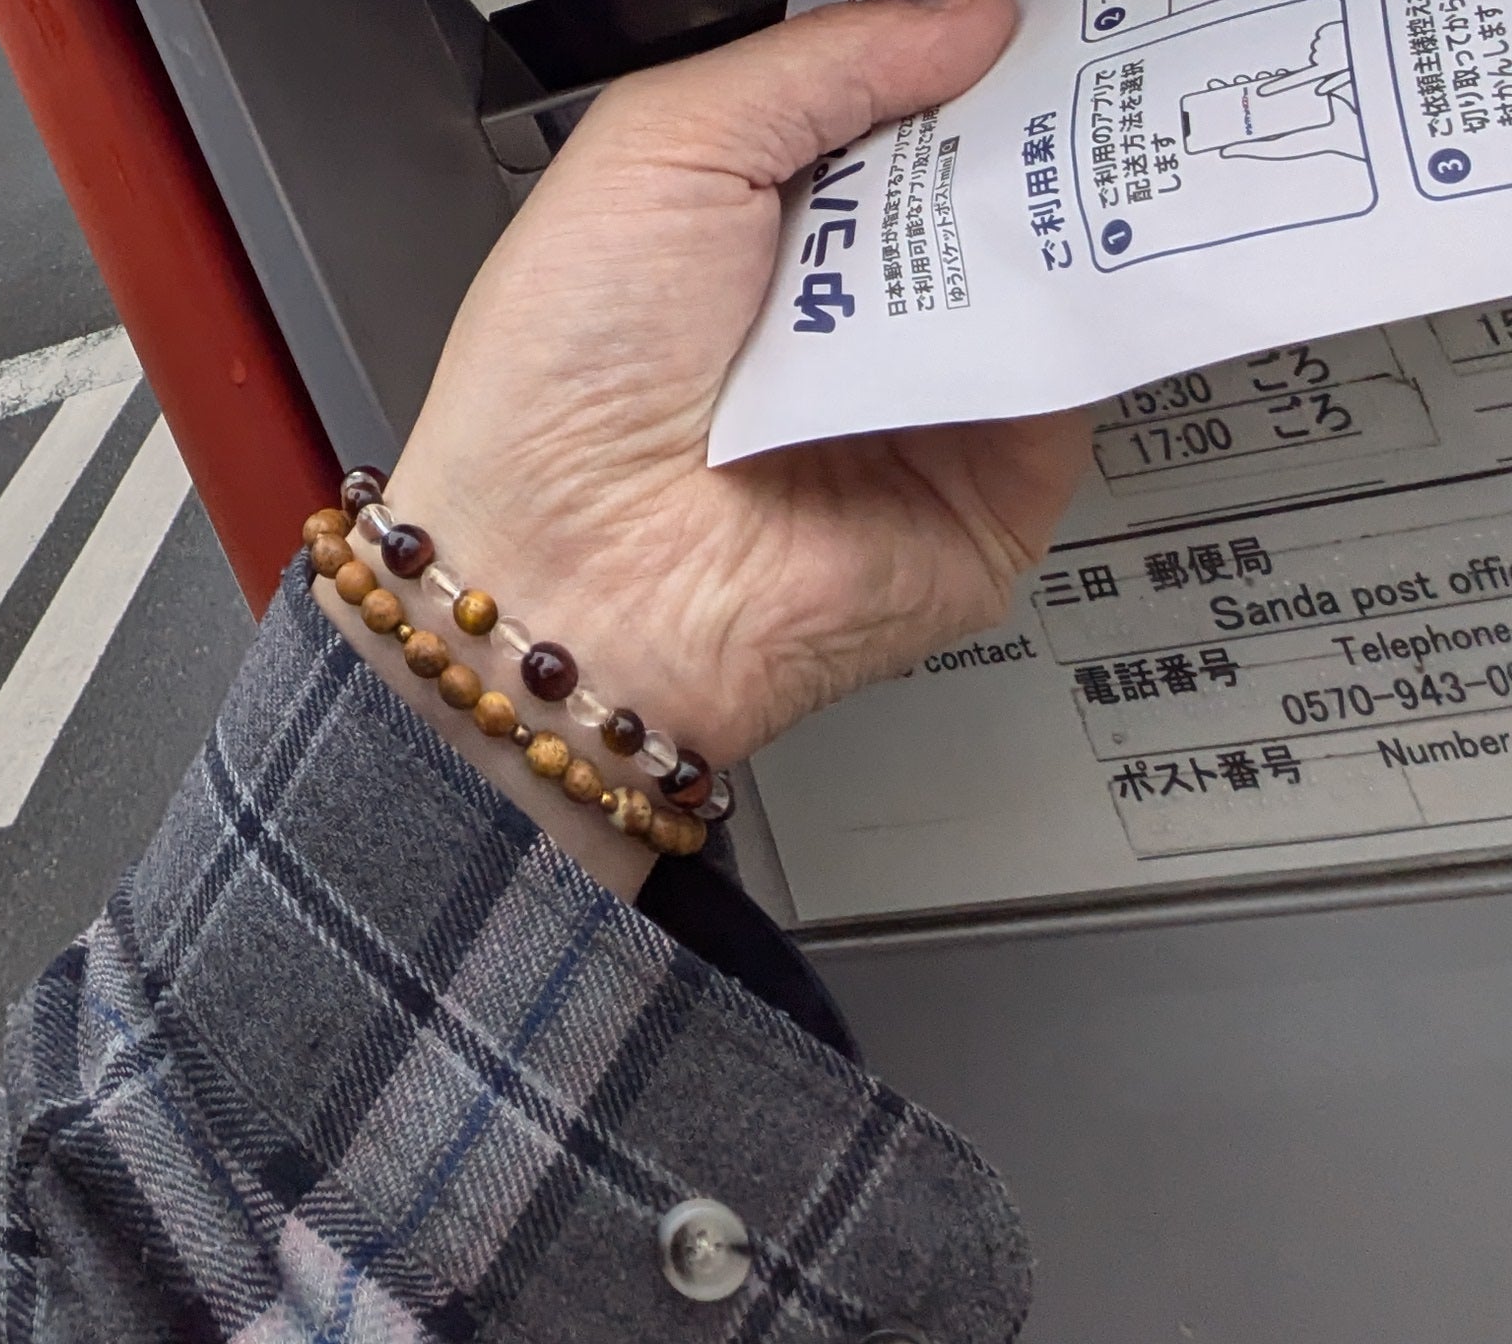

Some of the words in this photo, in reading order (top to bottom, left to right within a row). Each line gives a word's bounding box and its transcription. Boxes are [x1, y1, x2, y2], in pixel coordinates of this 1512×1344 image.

[1090, 69, 1120, 208] ご利用のアプリで
[1118, 58, 1153, 204] 配送方法を選択
[1150, 132, 1182, 195] します
[1021, 111, 1073, 271] ご利用案内
[1247, 345, 1330, 392] ごろ
[1130, 417, 1233, 464] 17:00
[1268, 392, 1352, 439] ごろ
[1039, 564, 1120, 607] 三田
[1143, 536, 1273, 592] 郵便局
[1208, 582, 1341, 632] Sanda
[1351, 571, 1438, 616] post
[1448, 555, 1512, 595] offi
[924, 633, 1038, 674] contact
[1073, 648, 1240, 705] 電話番号
[1331, 622, 1511, 665] Telephone
[1281, 661, 1512, 726] 0570-943-0
[1113, 744, 1301, 802] ポスト番号
[1377, 730, 1510, 768] Number
